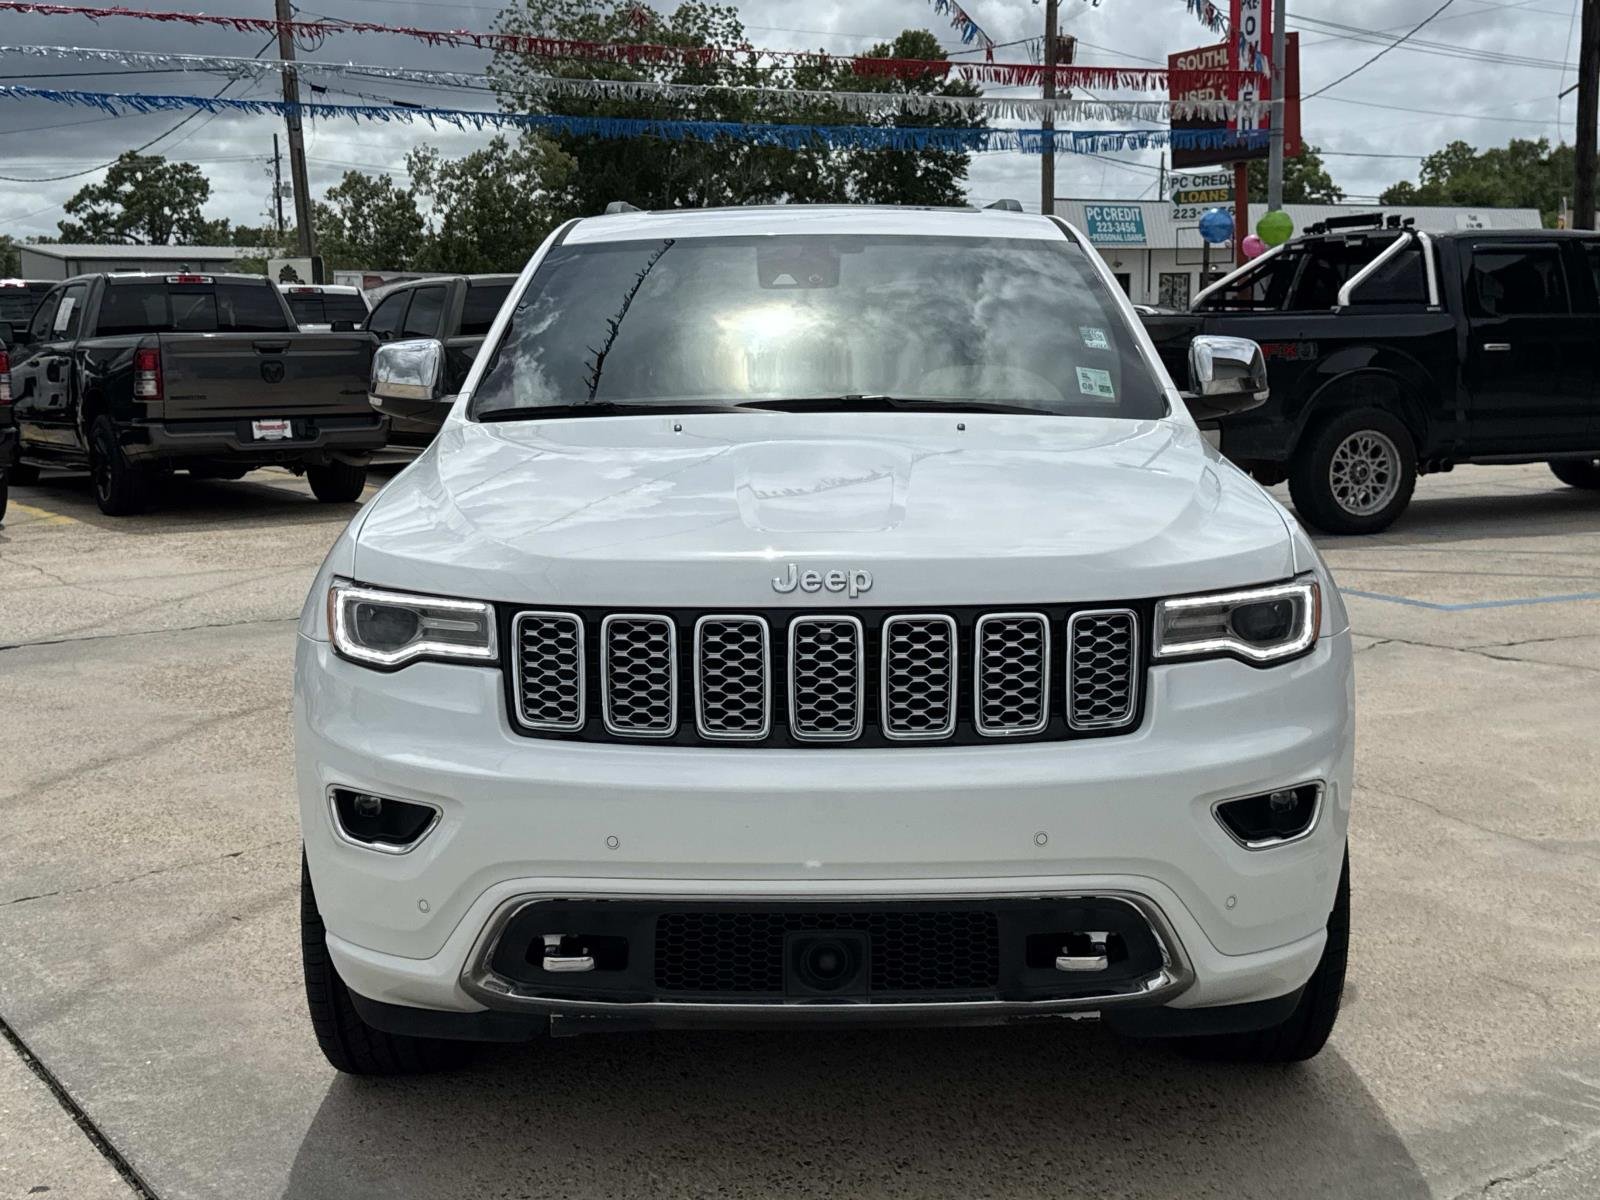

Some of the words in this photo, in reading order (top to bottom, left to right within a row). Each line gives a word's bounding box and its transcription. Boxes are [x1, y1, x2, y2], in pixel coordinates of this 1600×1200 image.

[1171, 176, 1188, 189] PC
[1180, 189, 1229, 203] LOANS
[1086, 207, 1102, 221] PC
[1103, 207, 1140, 222] CREDIT
[1096, 222, 1137, 233] 223-3456
[771, 562, 874, 598] Jeep
